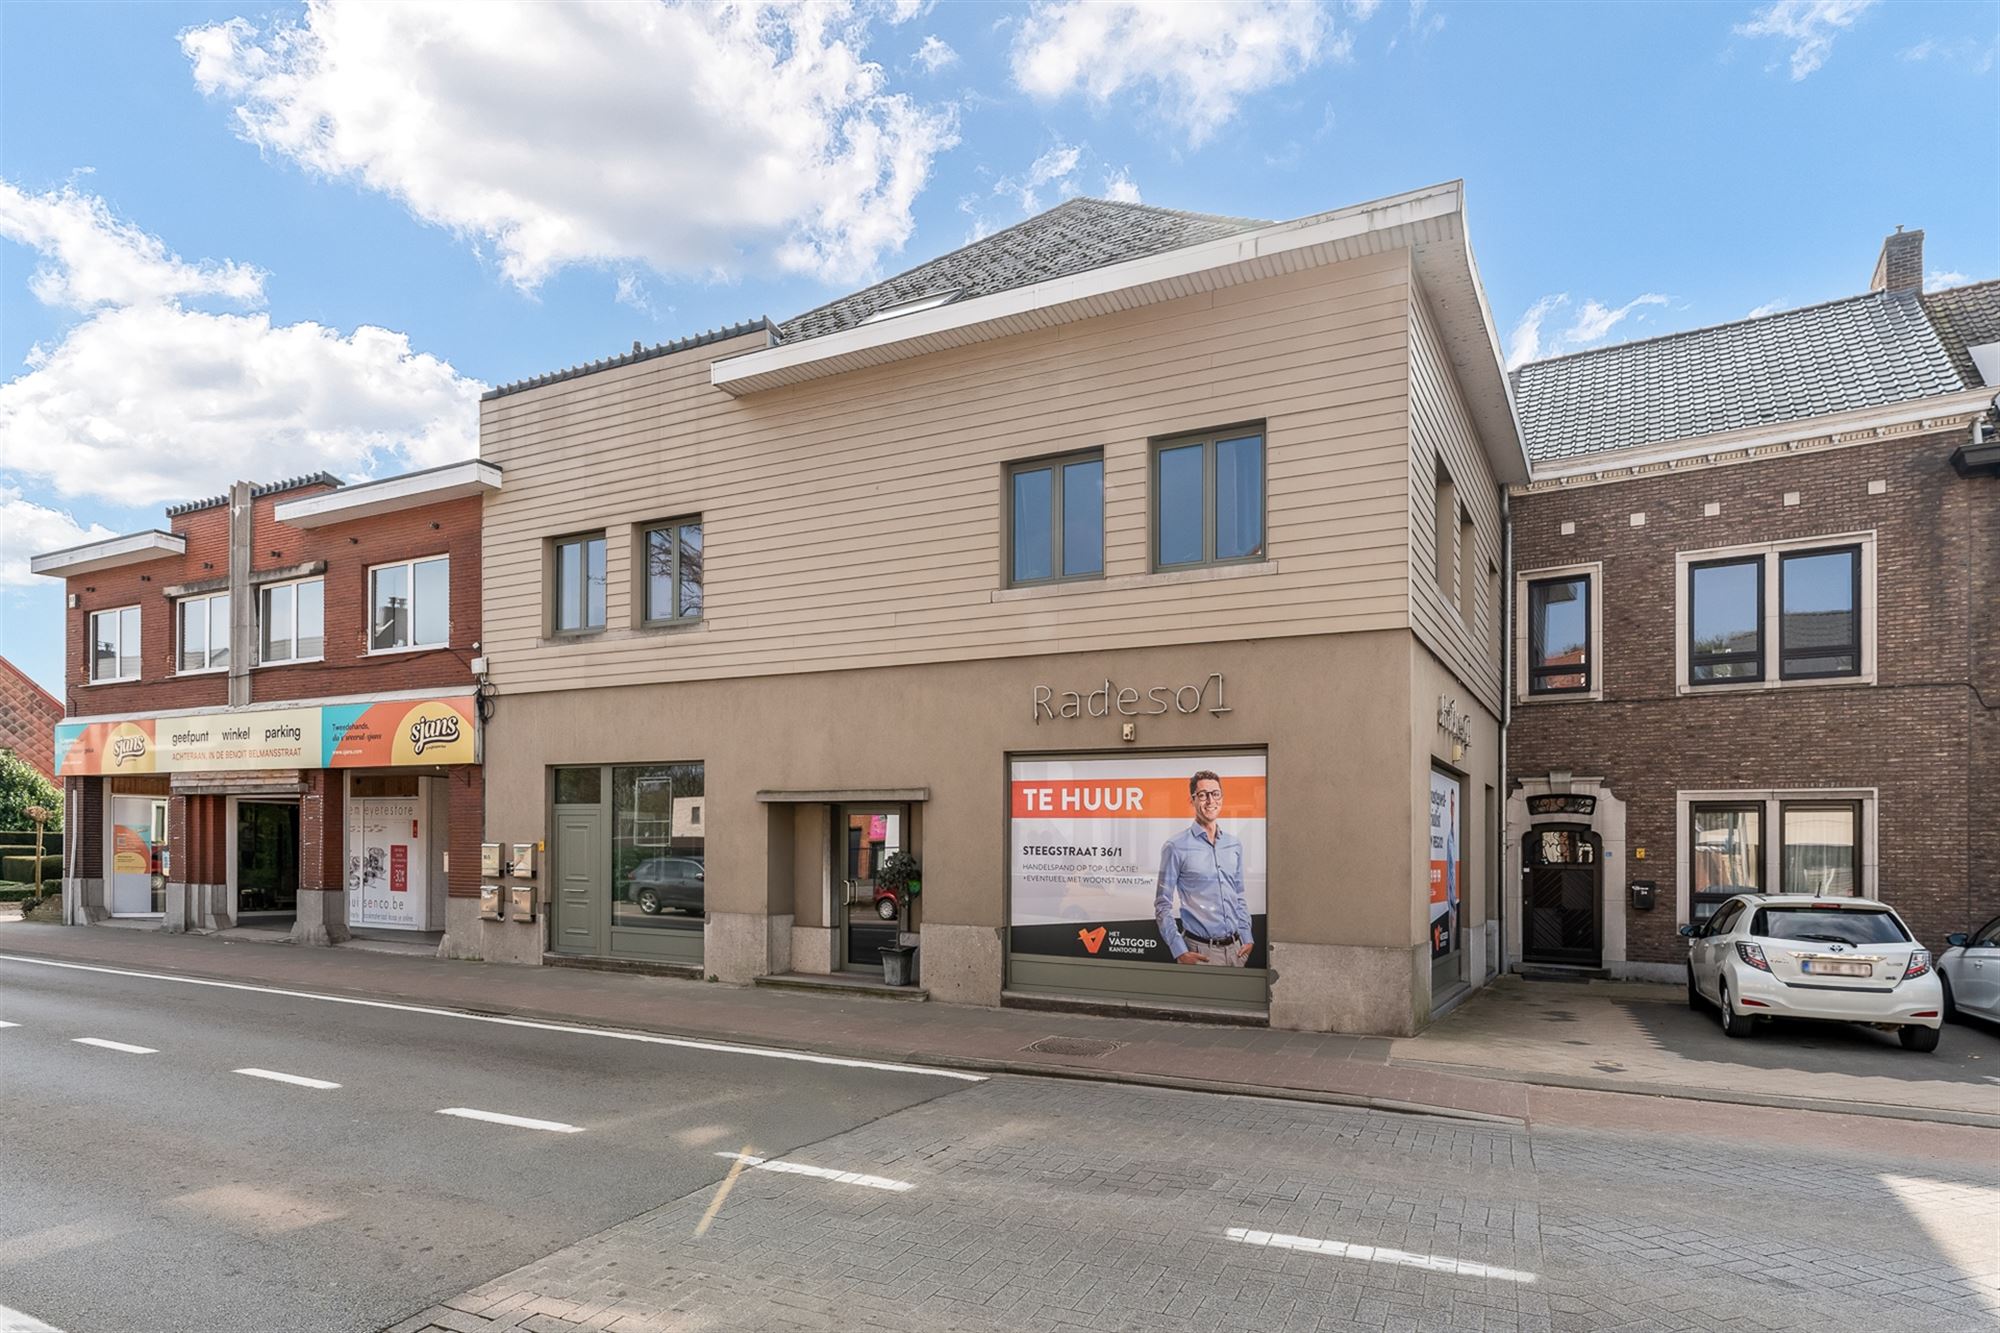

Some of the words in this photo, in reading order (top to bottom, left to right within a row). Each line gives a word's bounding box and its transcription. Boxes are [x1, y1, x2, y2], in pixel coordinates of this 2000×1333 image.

[172, 730, 209, 747] geefpunt
[221, 726, 250, 741] winkel
[264, 724, 301, 742] parking
[410, 715, 460, 755] sjans
[113, 735, 146, 768] sjans
[216, 750, 224, 759] DE
[248, 747, 302, 758] BELMANSSTRAAT
[1023, 788, 1053, 811] TE
[1061, 787, 1144, 811] HUUR
[1023, 846, 1098, 857] STEEGSTRAAT
[1100, 847, 1122, 857] 36/1
[1022, 863, 1075, 872] HANDELSPAND
[1076, 864, 1087, 872] OP
[1082, 876, 1116, 884] WOONST
[1109, 938, 1157, 948] VASTGOED
[1109, 946, 1144, 954] KANTOOR.BE
